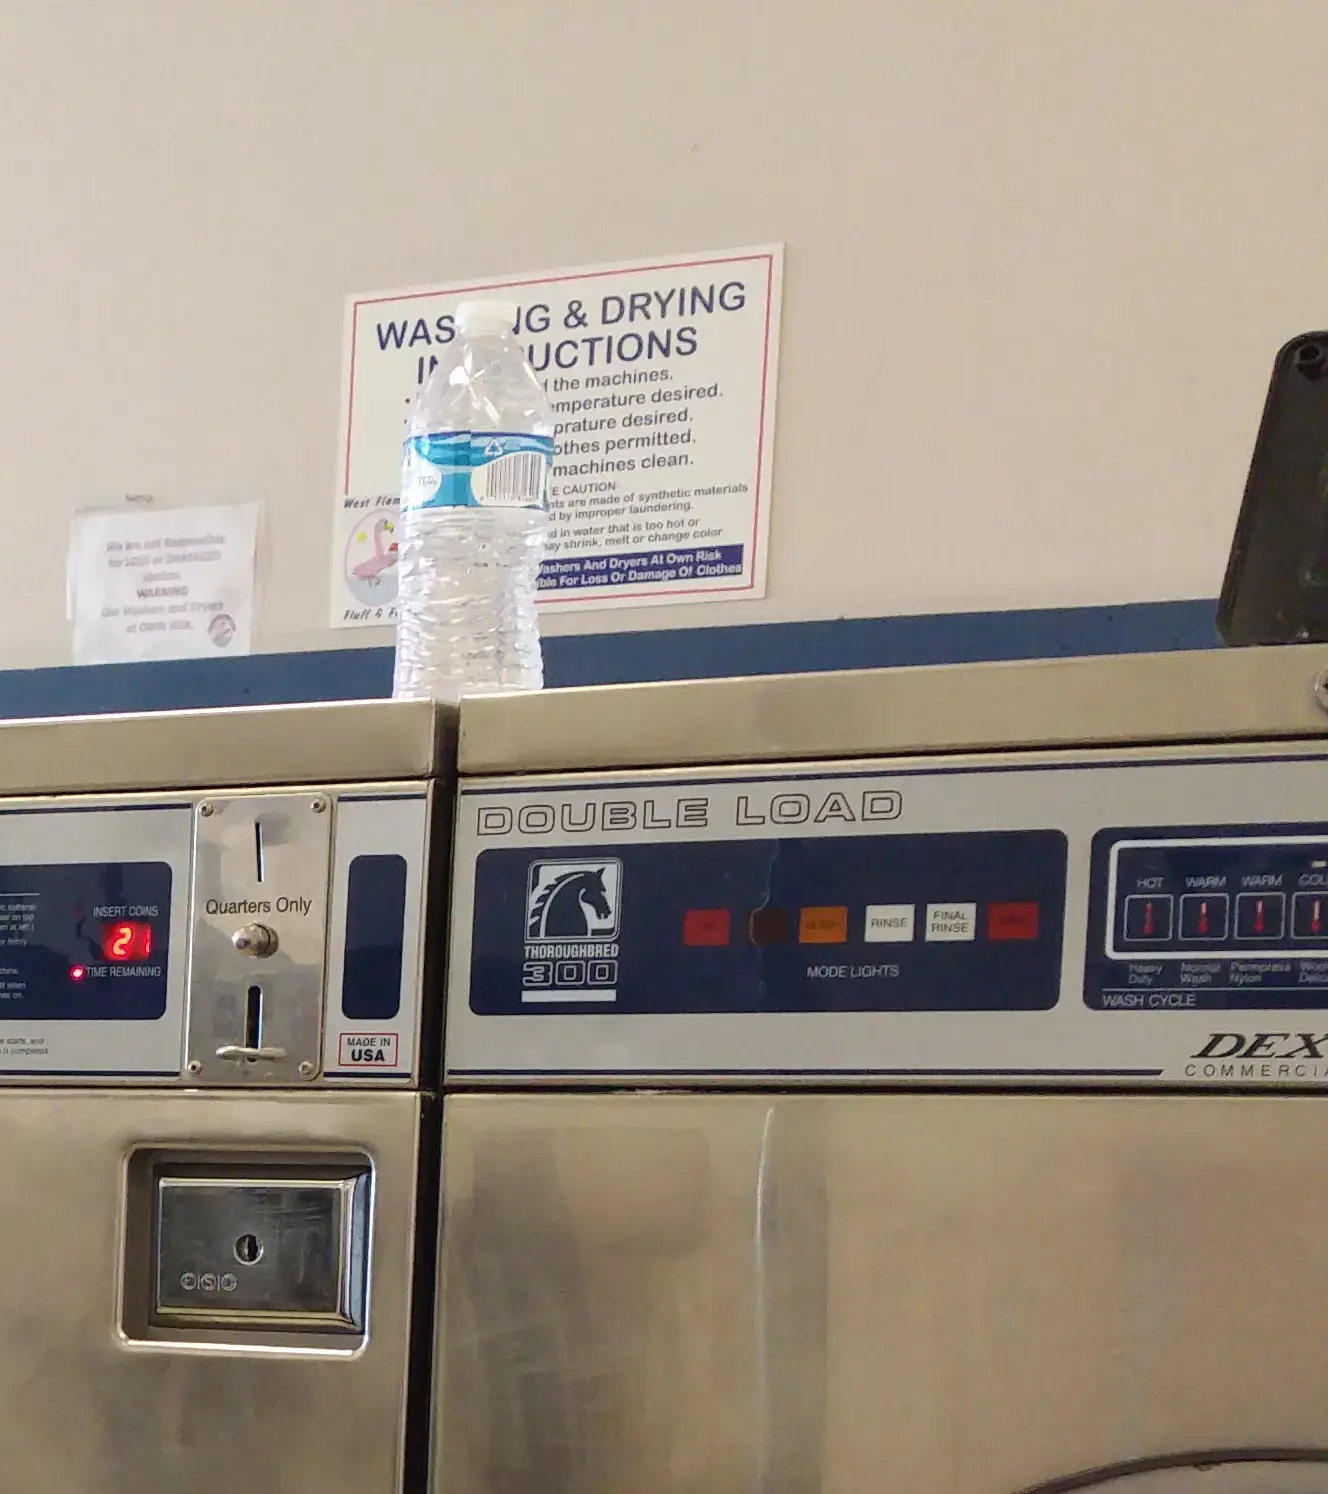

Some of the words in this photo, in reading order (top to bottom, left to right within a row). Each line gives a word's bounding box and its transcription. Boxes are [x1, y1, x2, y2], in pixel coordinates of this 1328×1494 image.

[377, 303, 550, 350] WASG
[563, 300, 588, 327] &
[601, 281, 746, 325] DRYING
[417, 326, 698, 384] IUCTIONS
[553, 377, 580, 392] the
[585, 369, 673, 388] machines.
[651, 383, 723, 403] desired.
[622, 407, 693, 428] desired.
[553, 438, 600, 456] othes
[605, 429, 696, 454] permitted.
[552, 458, 636, 477] machines
[641, 453, 694, 470] clean.
[344, 497, 371, 509] West
[568, 498, 586, 507] are
[589, 495, 620, 506] made
[623, 493, 634, 504] of
[639, 488, 691, 504] synthetic
[694, 483, 748, 497] materials
[559, 511, 572, 522] by
[575, 507, 626, 521] improper
[629, 501, 694, 516] laundering.
[560, 528, 570, 538] in
[573, 526, 605, 537] water
[608, 523, 629, 534] that
[632, 521, 642, 531] is
[645, 520, 664, 530] too
[666, 518, 685, 529] hot
[687, 517, 701, 527] or
[563, 537, 602, 549] shrink,
[605, 534, 630, 546] melt
[633, 534, 644, 544] or
[647, 530, 690, 544] change
[693, 527, 722, 539] color
[583, 559, 607, 571] And
[609, 554, 648, 570] Dryers
[651, 553, 665, 566] At
[666, 552, 693, 564] Own
[696, 549, 722, 562] Risk
[560, 574, 579, 586] For
[581, 572, 609, 584] Loss
[611, 571, 625, 582] Or
[628, 567, 677, 581] Damage
[678, 565, 693, 577] Of
[696, 562, 742, 577] Clothes
[137, 585, 189, 598] WARNING
[343, 609, 369, 620] Fluff
[476, 798, 710, 837] DOUBLE
[735, 789, 902, 826] LOAD
[1136, 877, 1164, 889] HOT
[1185, 874, 1227, 888] WARM
[1241, 874, 1283, 888] WARM
[93, 906, 127, 918] INSERT
[128, 906, 158, 917] COINS
[205, 899, 271, 916] Quarters
[276, 897, 312, 916] Only
[932, 911, 968, 921] FINAL
[870, 917, 908, 929] RINSE
[931, 922, 969, 933] RINSE
[524, 944, 620, 959] THOROUGHBRED
[86, 966, 107, 977] TIME
[109, 966, 161, 977] REMAINING
[521, 960, 619, 987] 300
[807, 966, 847, 978] MODE
[850, 965, 900, 977] LIGHTS
[1129, 975, 1154, 985] Duty
[1230, 974, 1263, 986] Nylon
[1102, 994, 1144, 1007] WASH
[1149, 994, 1197, 1008] CYCLE
[347, 1037, 375, 1047] MADE
[380, 1037, 391, 1047] IN
[1190, 1033, 1328, 1060] DEX
[351, 1049, 385, 1062] USA
[1184, 1064, 1328, 1078] COMMERCI
